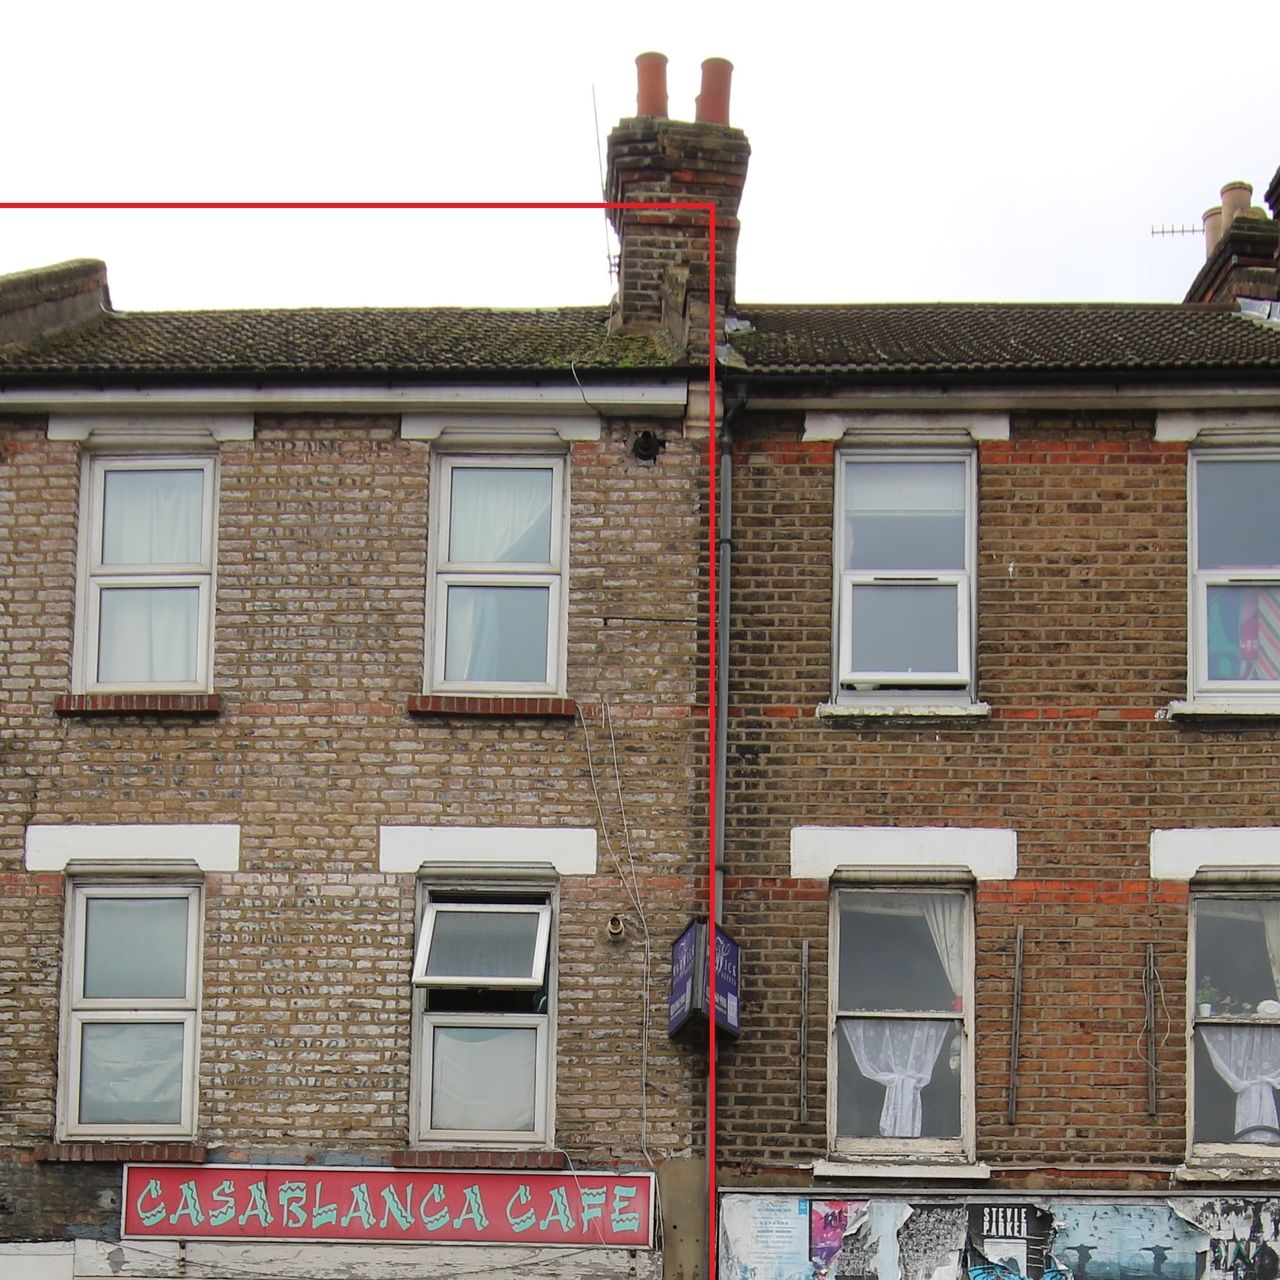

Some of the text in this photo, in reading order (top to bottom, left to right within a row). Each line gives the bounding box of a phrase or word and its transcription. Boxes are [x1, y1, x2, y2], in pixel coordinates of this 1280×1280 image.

[136, 1179, 640, 1234] CASABLANCA CAFE
[983, 1207, 1027, 1222] STEVIE
[983, 1222, 1027, 1236] PARKER
